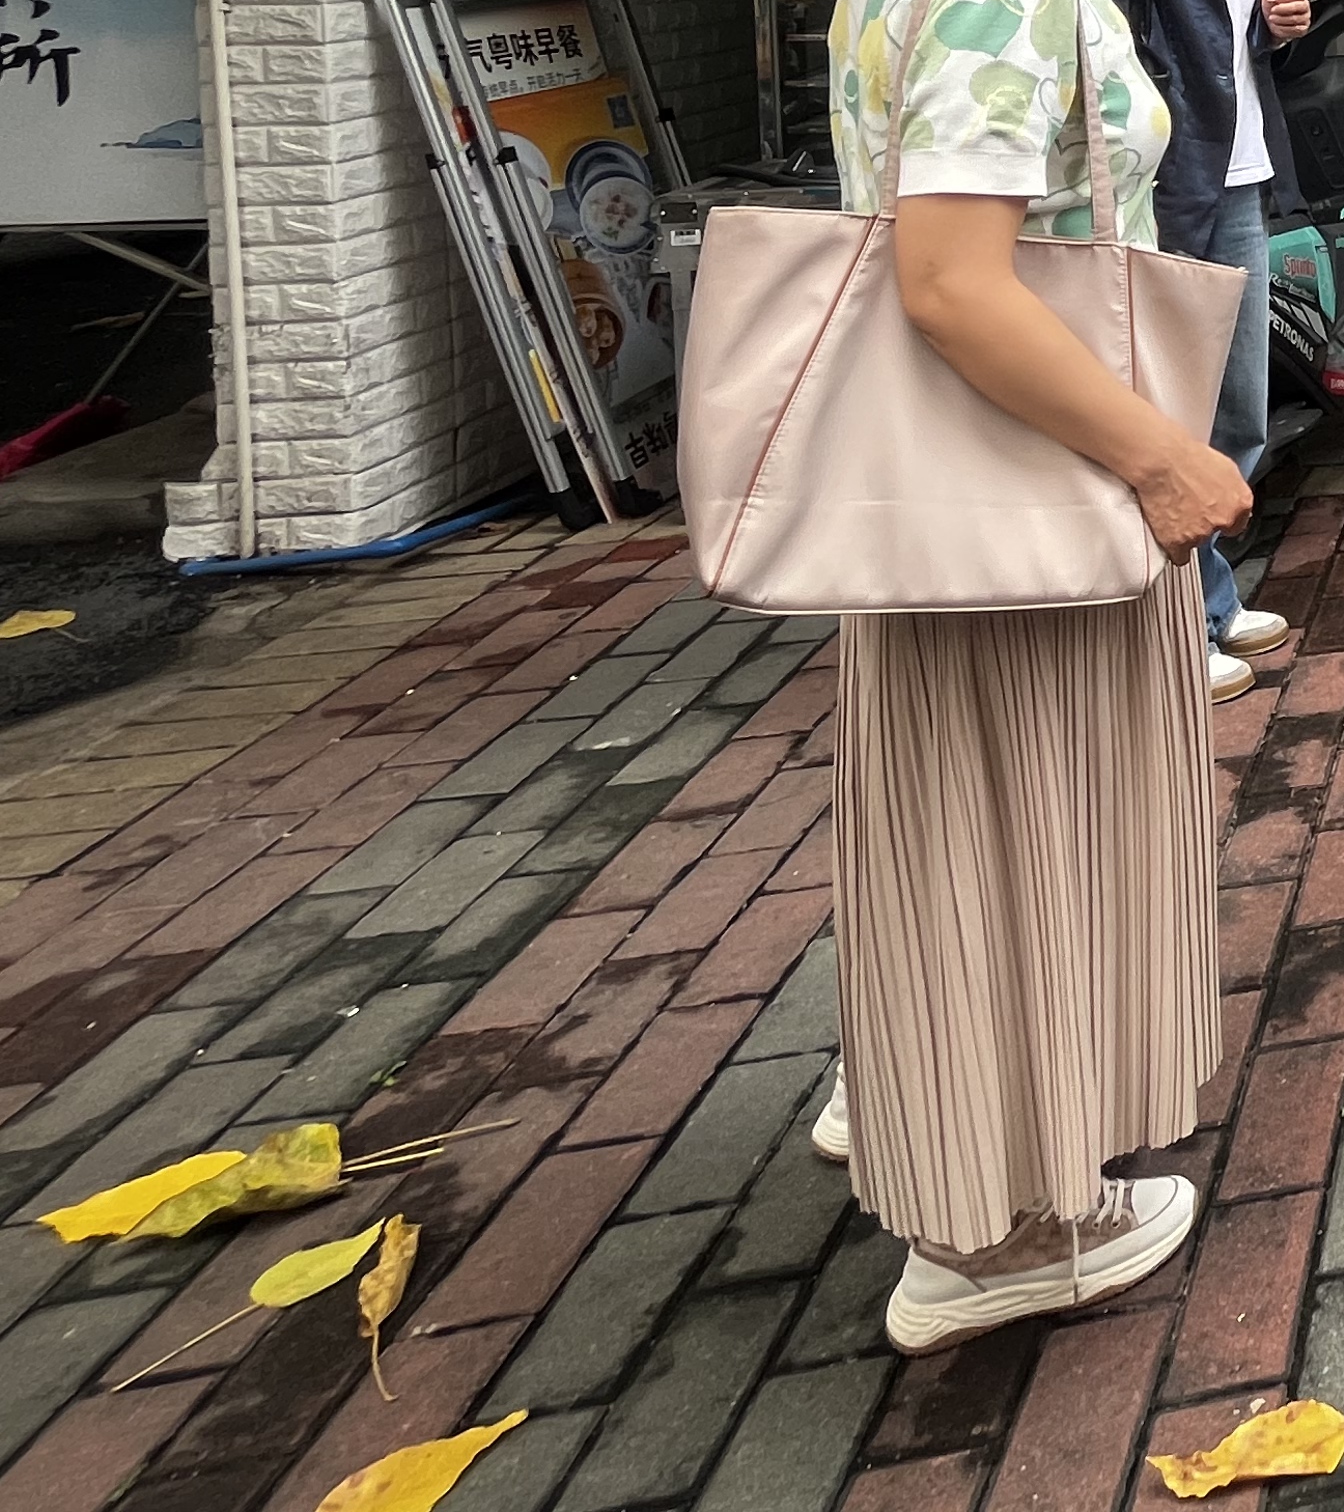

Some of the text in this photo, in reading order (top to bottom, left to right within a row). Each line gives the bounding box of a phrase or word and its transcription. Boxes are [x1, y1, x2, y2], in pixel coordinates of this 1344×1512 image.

[435, 24, 584, 79] 气粤味早餐
